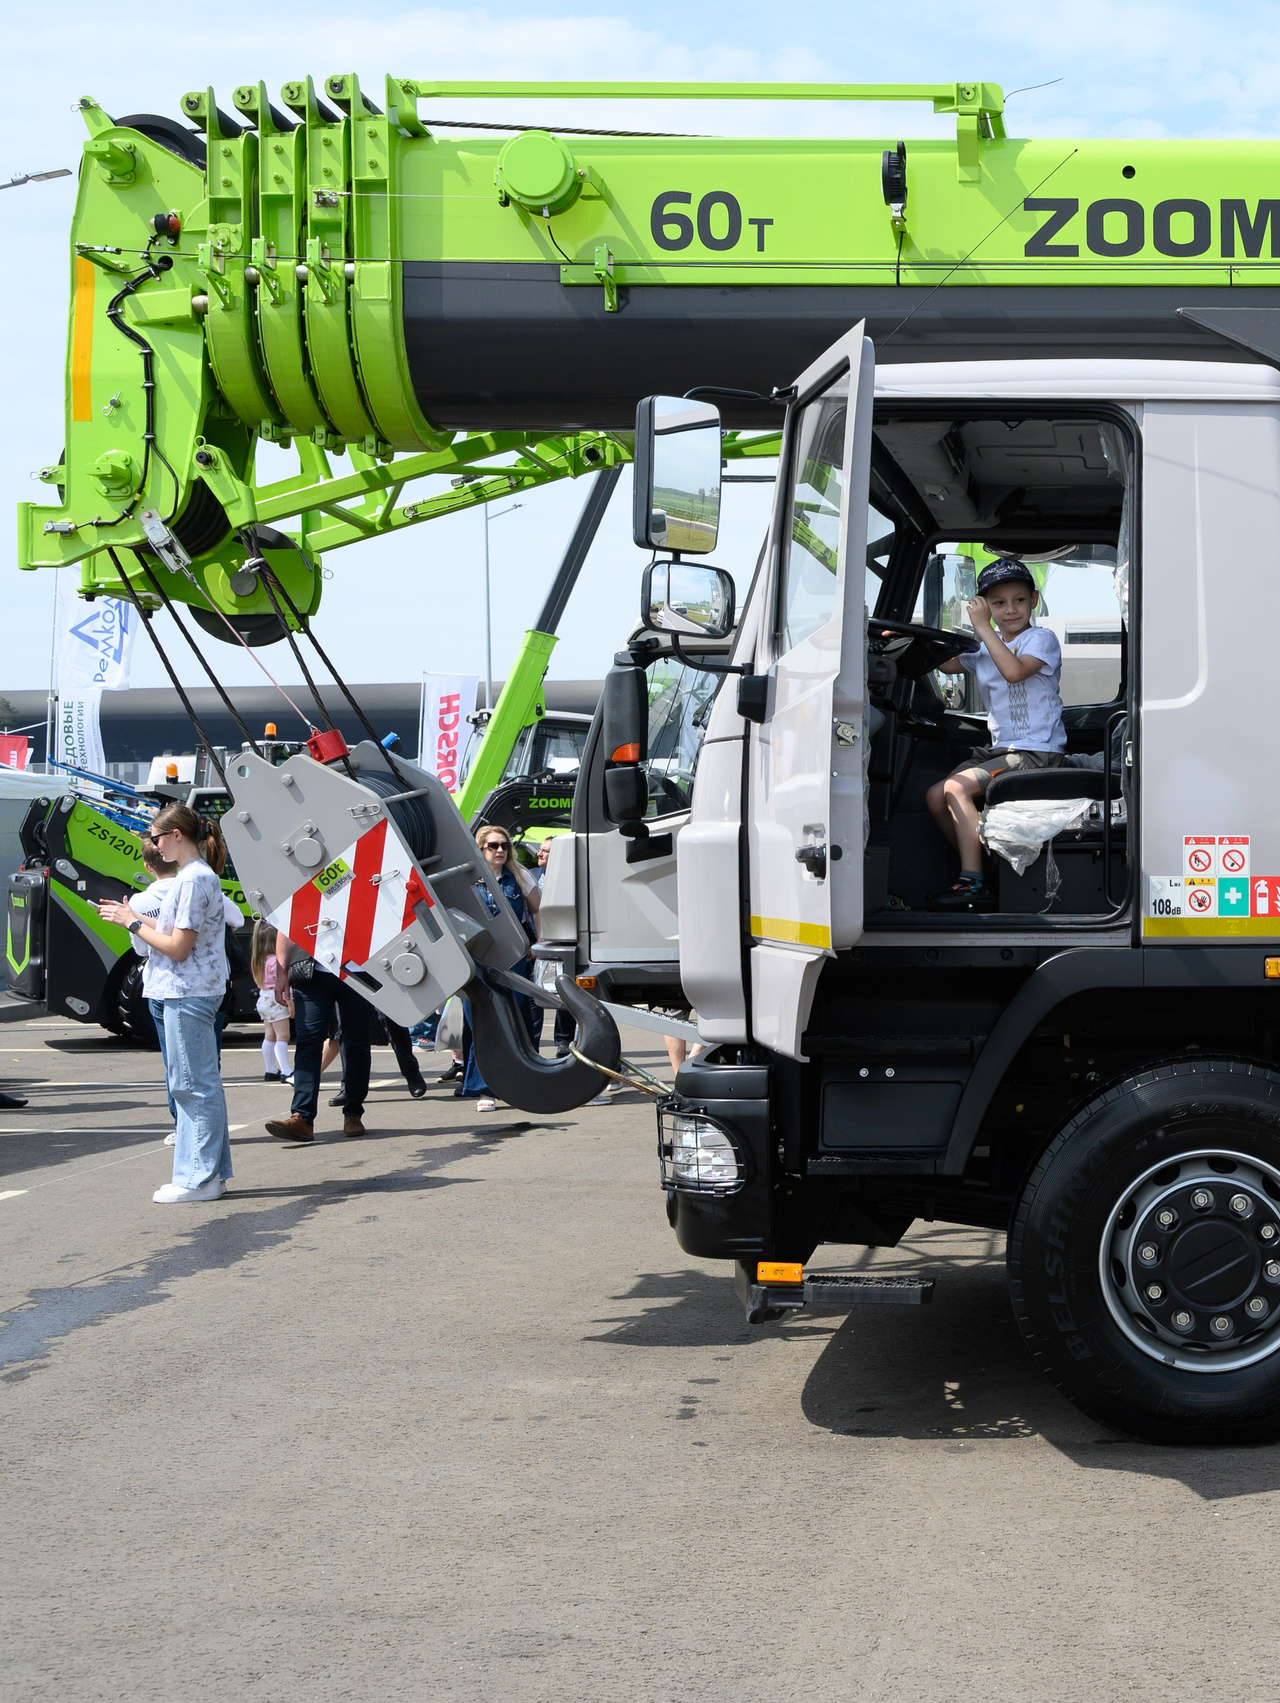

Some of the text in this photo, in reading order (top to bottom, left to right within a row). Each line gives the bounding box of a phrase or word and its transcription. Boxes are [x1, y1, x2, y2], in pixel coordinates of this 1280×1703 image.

[529, 798, 574, 809] ZOOM
[318, 863, 345, 887] 60t
[1045, 1146, 1111, 1361] BELSHINA
